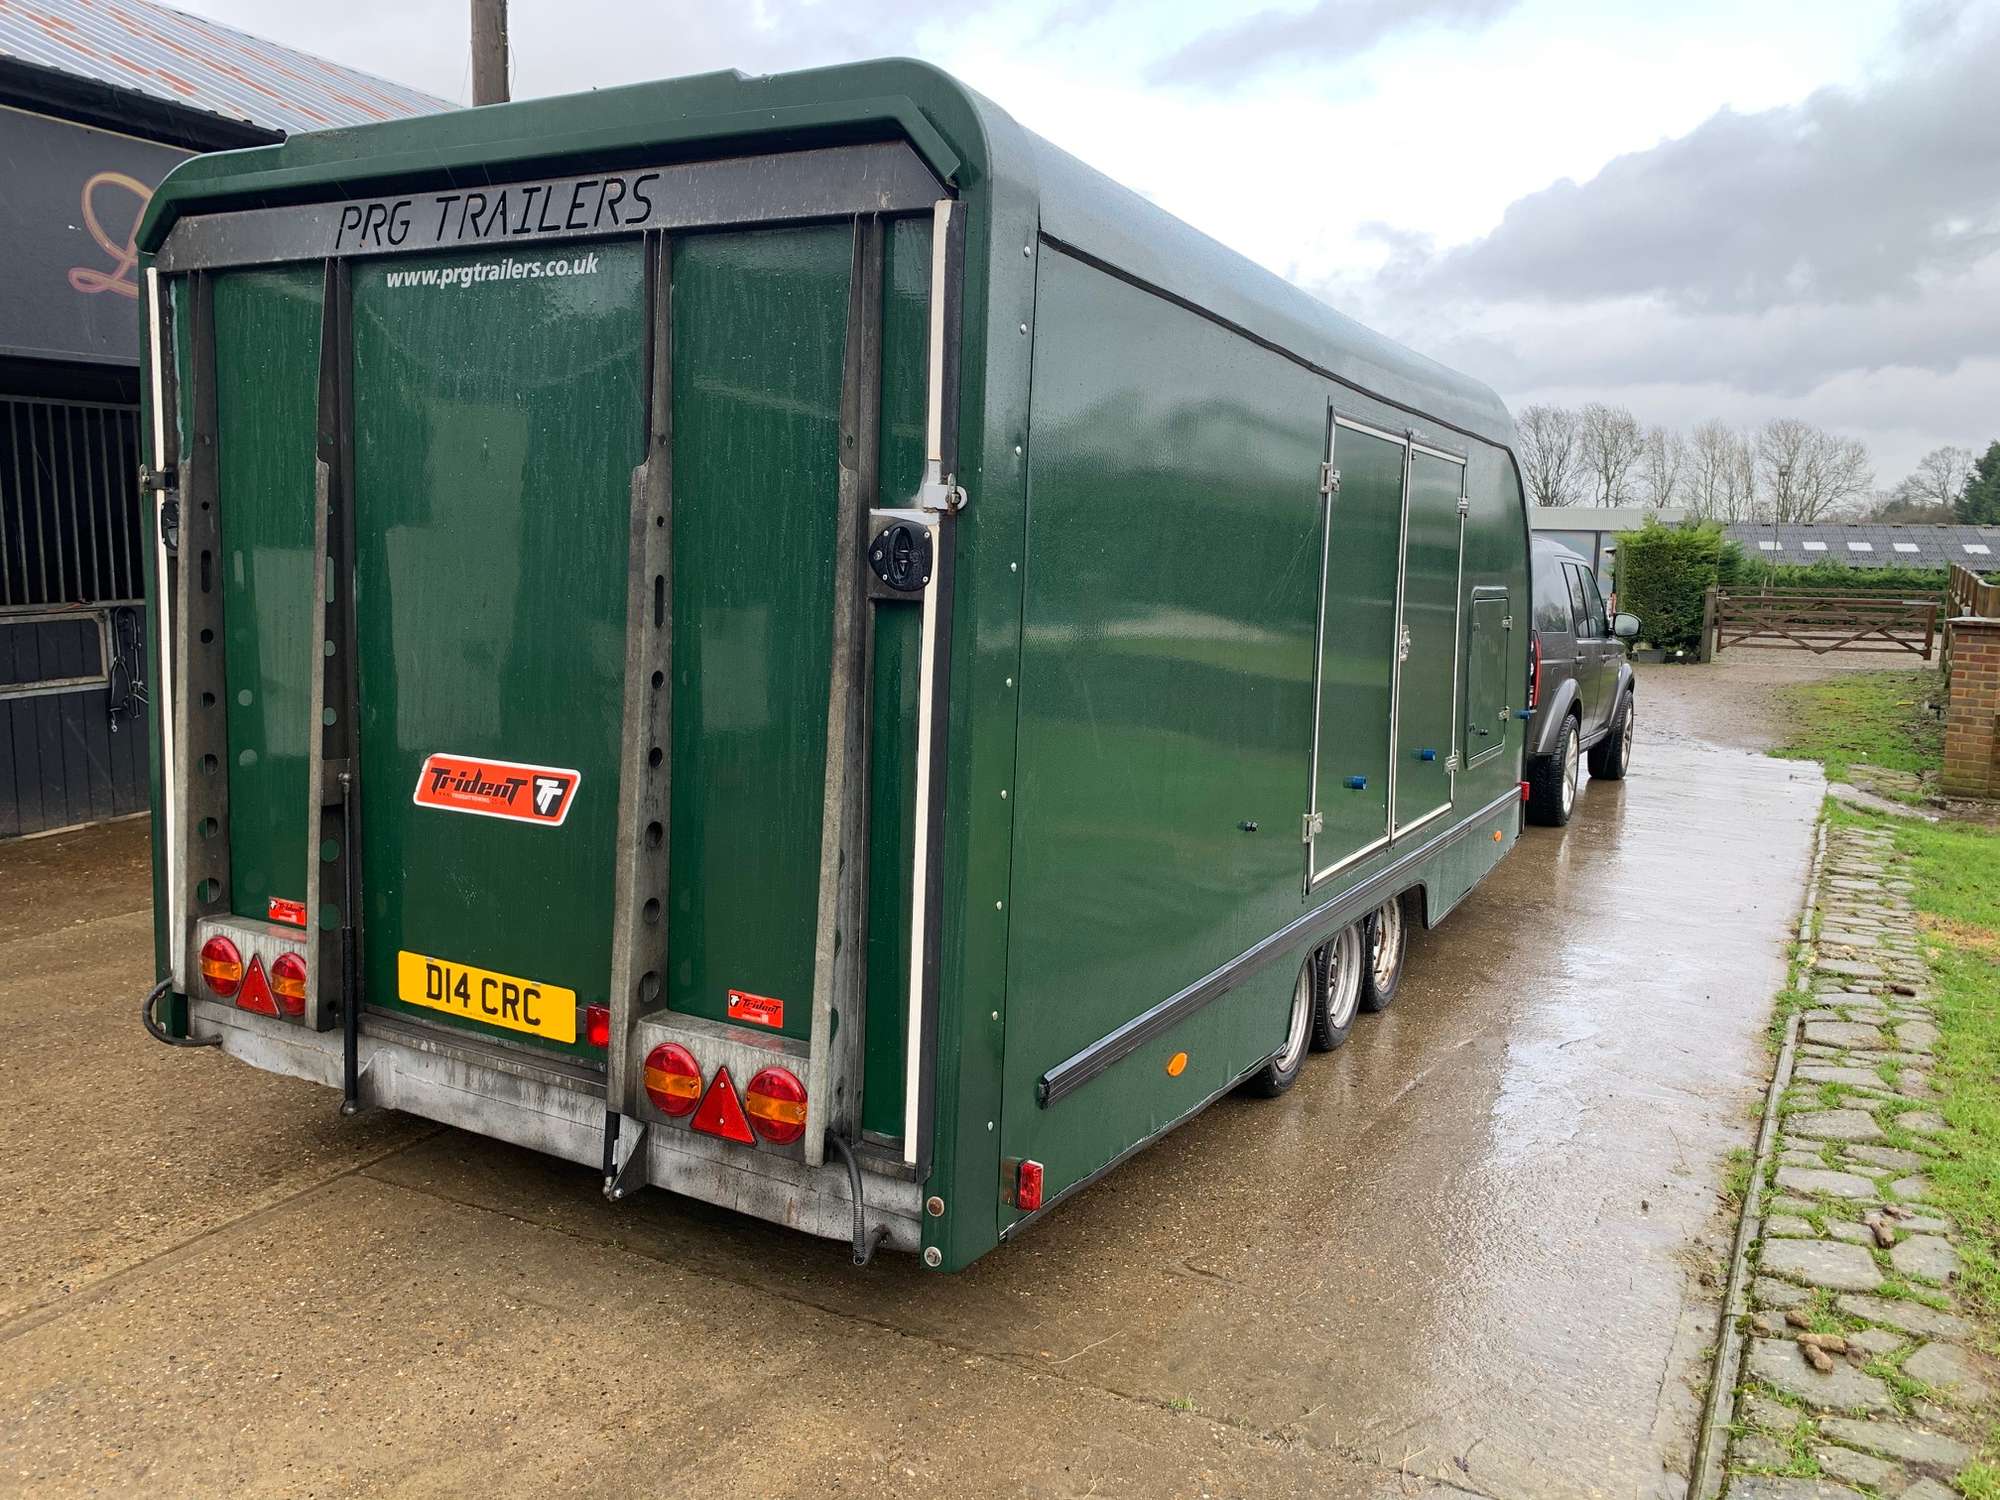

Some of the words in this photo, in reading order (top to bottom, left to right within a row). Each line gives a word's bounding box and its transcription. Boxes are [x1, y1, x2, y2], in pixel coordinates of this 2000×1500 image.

[335, 200, 412, 250] PRG
[435, 173, 660, 242] TRAILERS
[386, 252, 600, 289] www.prgtrailers.co.uk
[425, 962, 471, 1009] D14
[481, 977, 542, 1027] CRC
